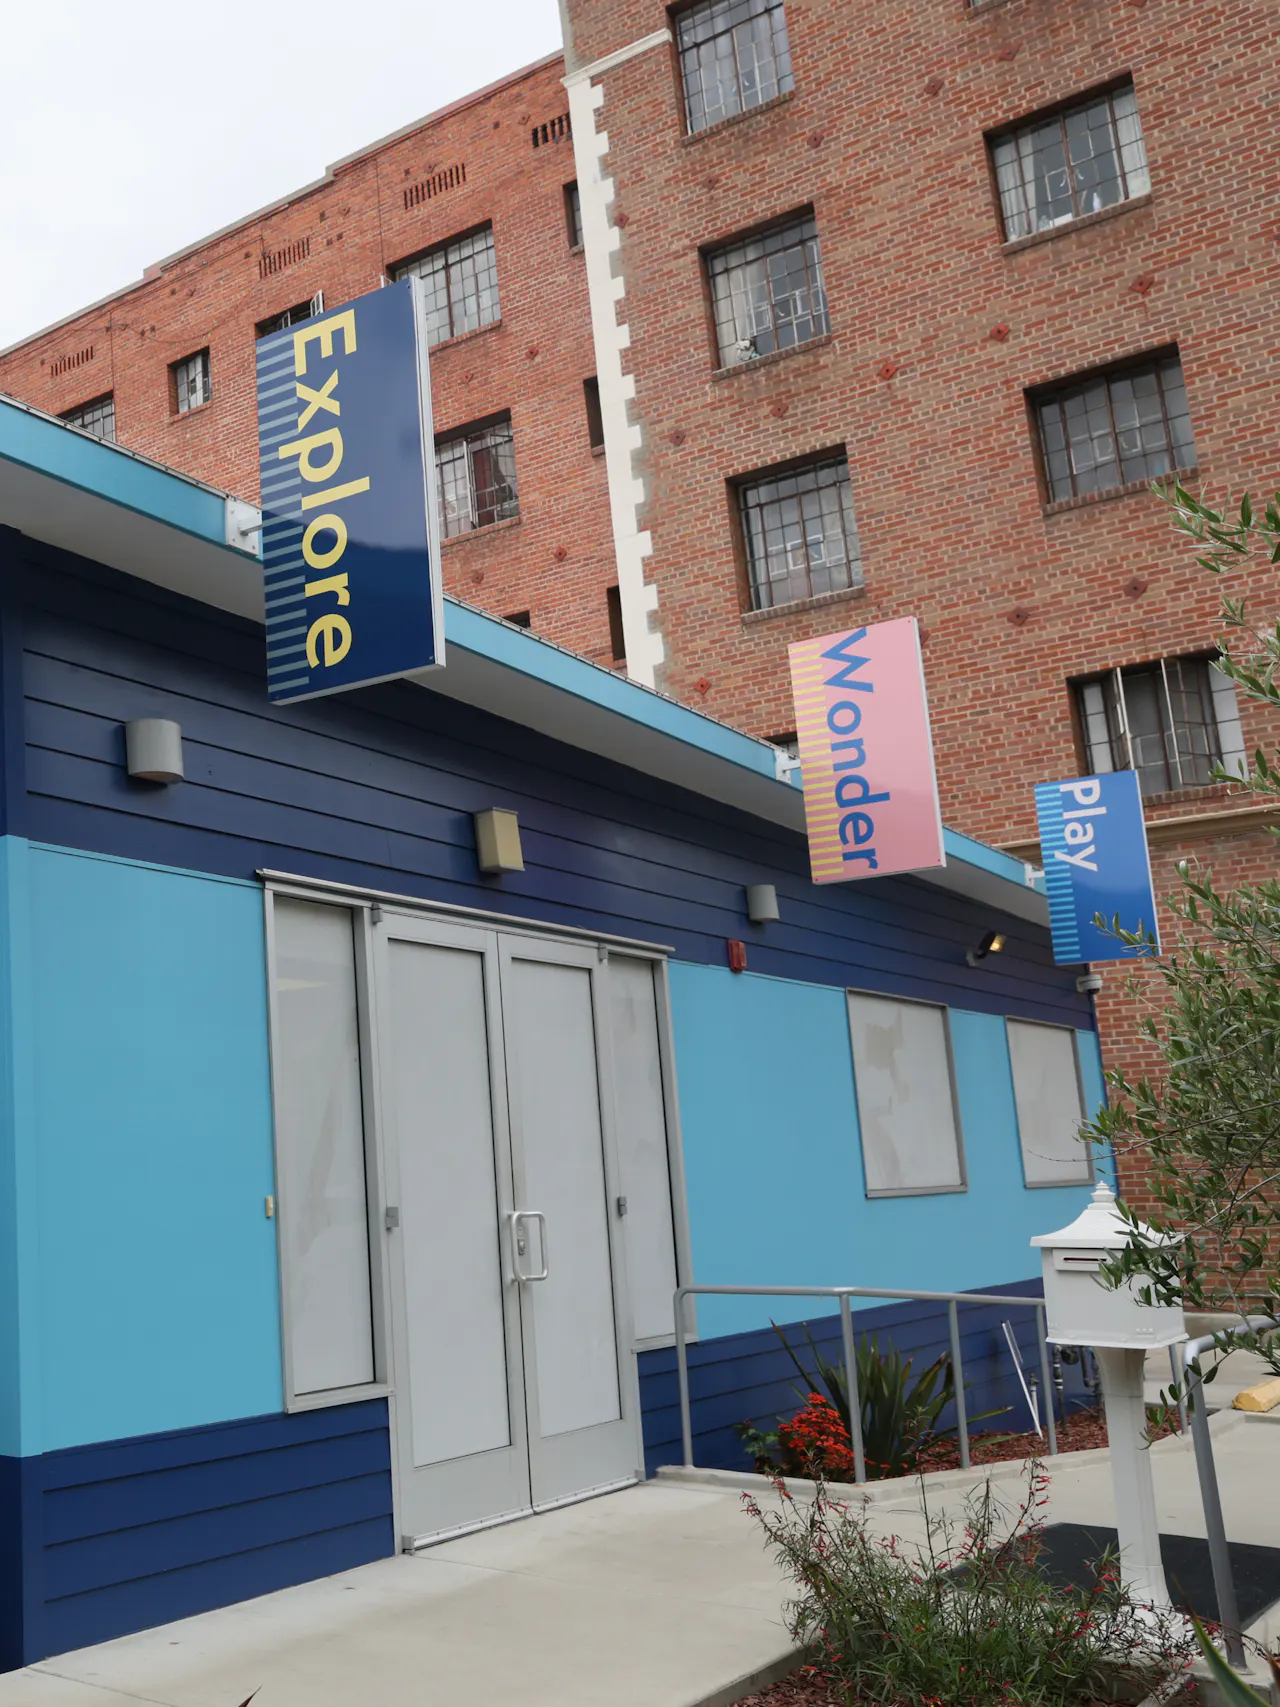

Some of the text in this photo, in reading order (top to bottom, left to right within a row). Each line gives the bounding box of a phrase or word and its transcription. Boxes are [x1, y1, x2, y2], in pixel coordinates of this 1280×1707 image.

[278, 308, 370, 669] Explore
[820, 627, 890, 869] Wonder
[1054, 779, 1107, 872] Play
